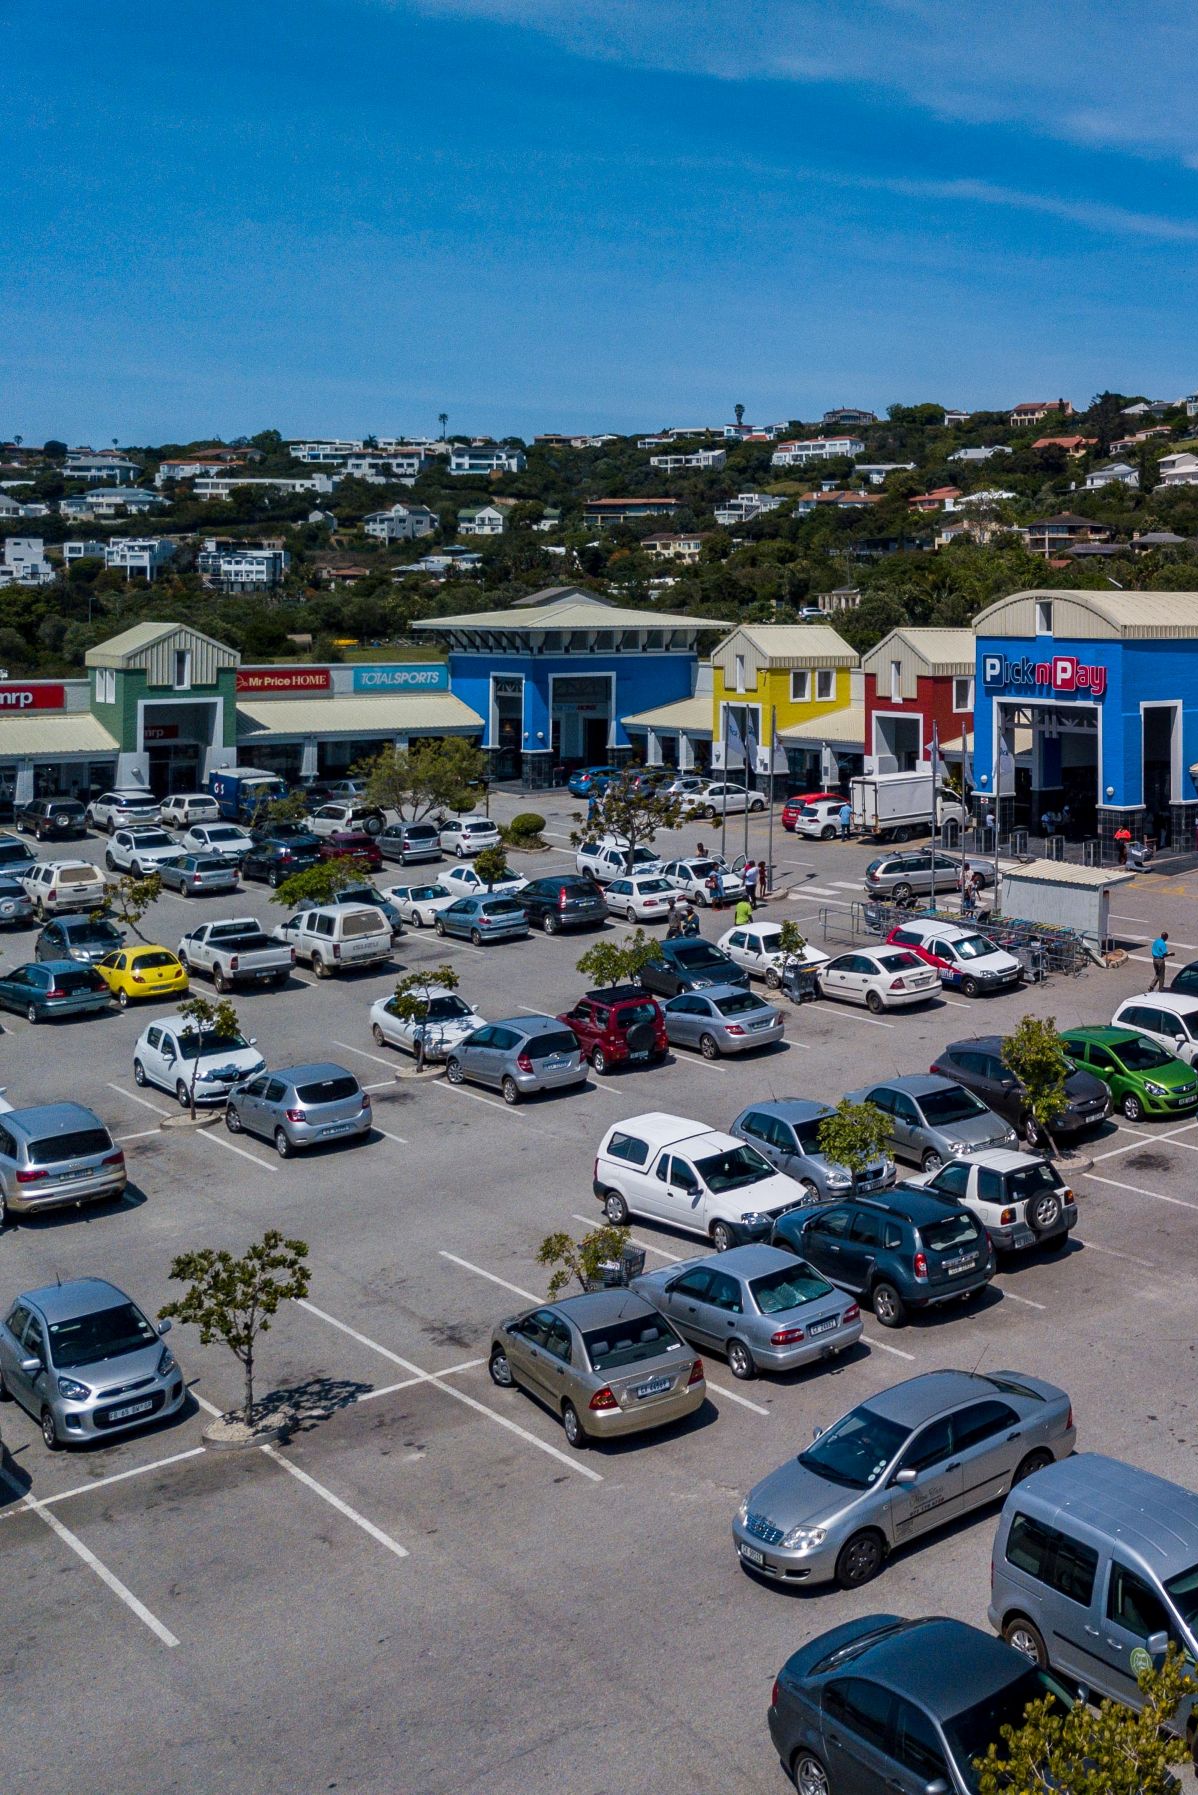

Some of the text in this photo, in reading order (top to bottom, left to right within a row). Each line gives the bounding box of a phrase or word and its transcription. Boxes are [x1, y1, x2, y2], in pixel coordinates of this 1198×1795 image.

[361, 671, 439, 684] TOTALSPORTS
[982, 653, 1034, 687] Pick
[1052, 656, 1105, 695] Pay
[249, 675, 326, 687] Mr Price HOME
